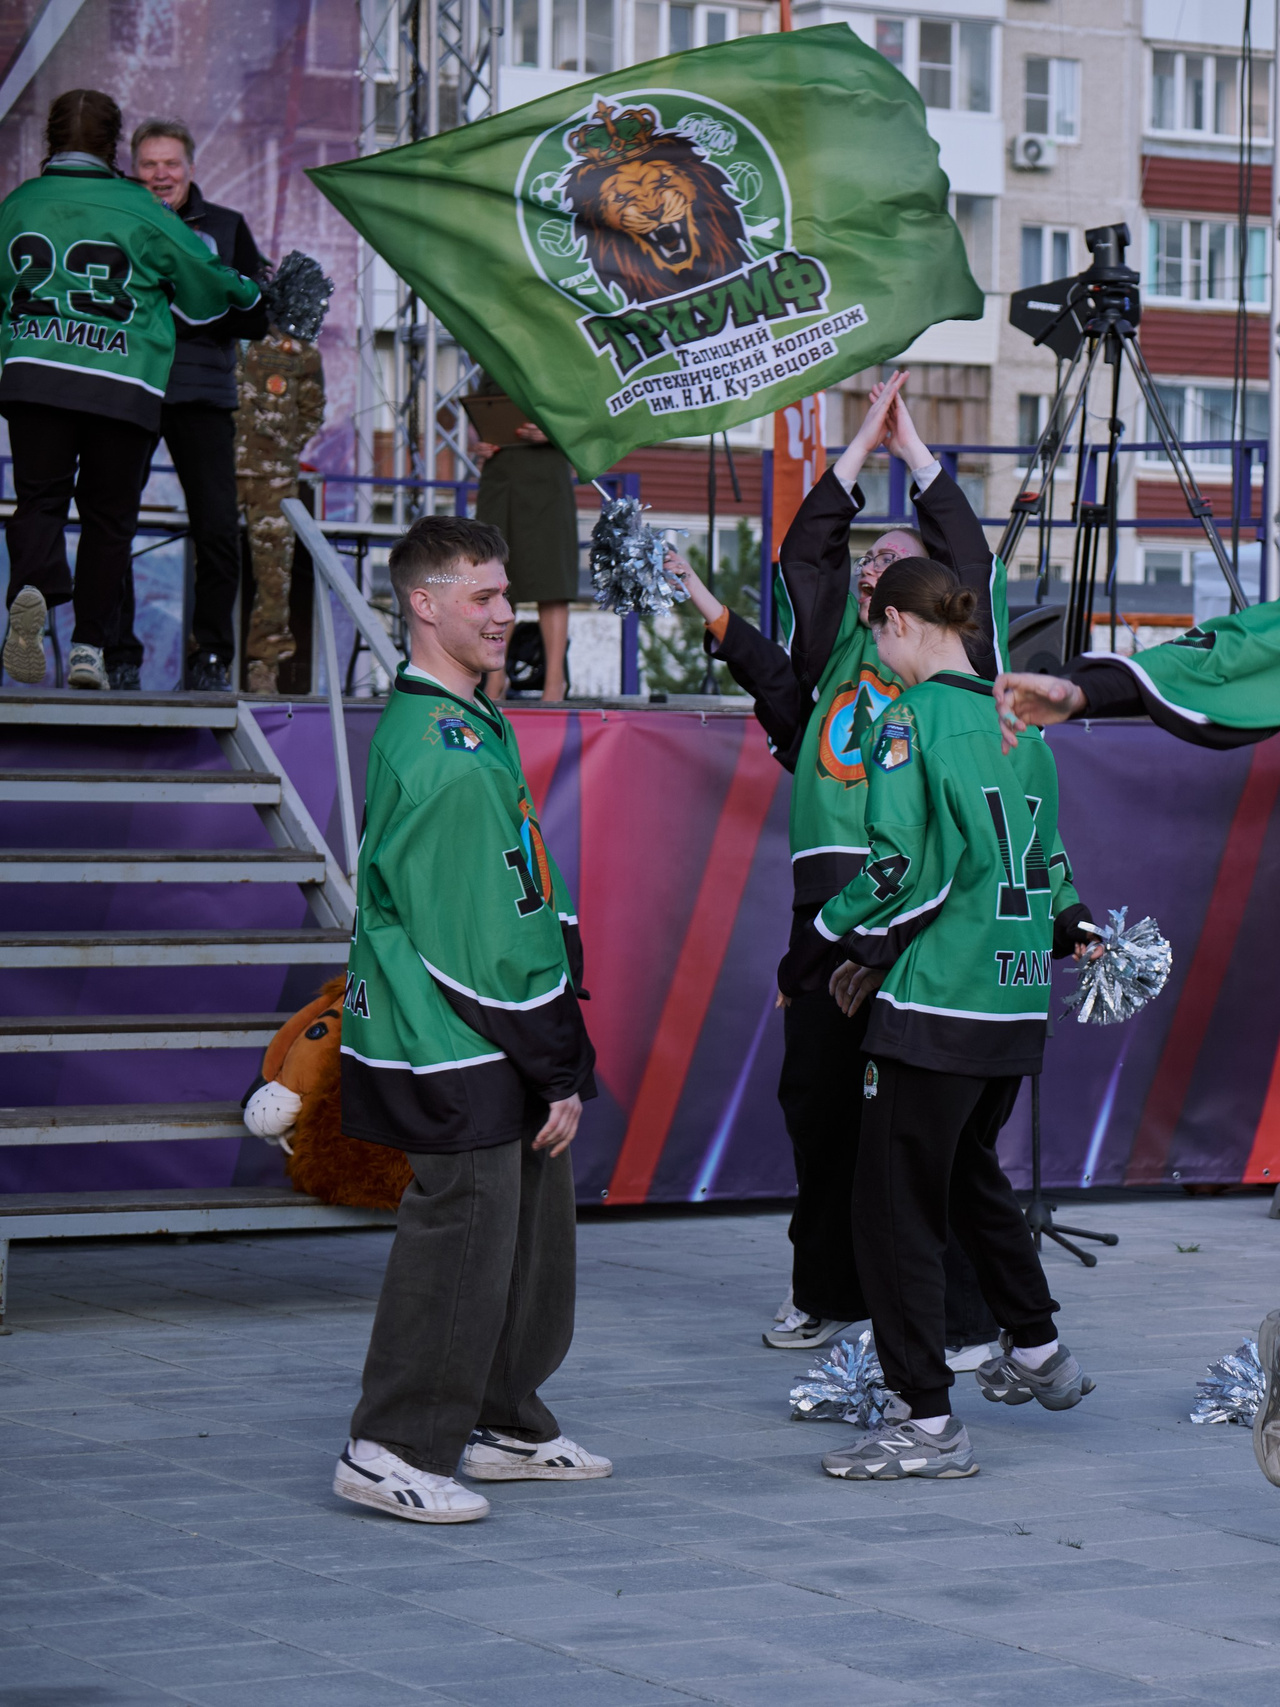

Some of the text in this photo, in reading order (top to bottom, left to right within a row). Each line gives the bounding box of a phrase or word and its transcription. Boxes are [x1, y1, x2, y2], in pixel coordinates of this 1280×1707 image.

[8, 231, 138, 325] 23
[581, 252, 826, 376] ТРИУМФ
[9, 317, 128, 355] ТАЛИЦА
[610, 307, 864, 413] лесотехнический колледж
[652, 395, 680, 412] им.
[724, 341, 834, 397] Кузнецова
[677, 326, 771, 367] Талицкий
